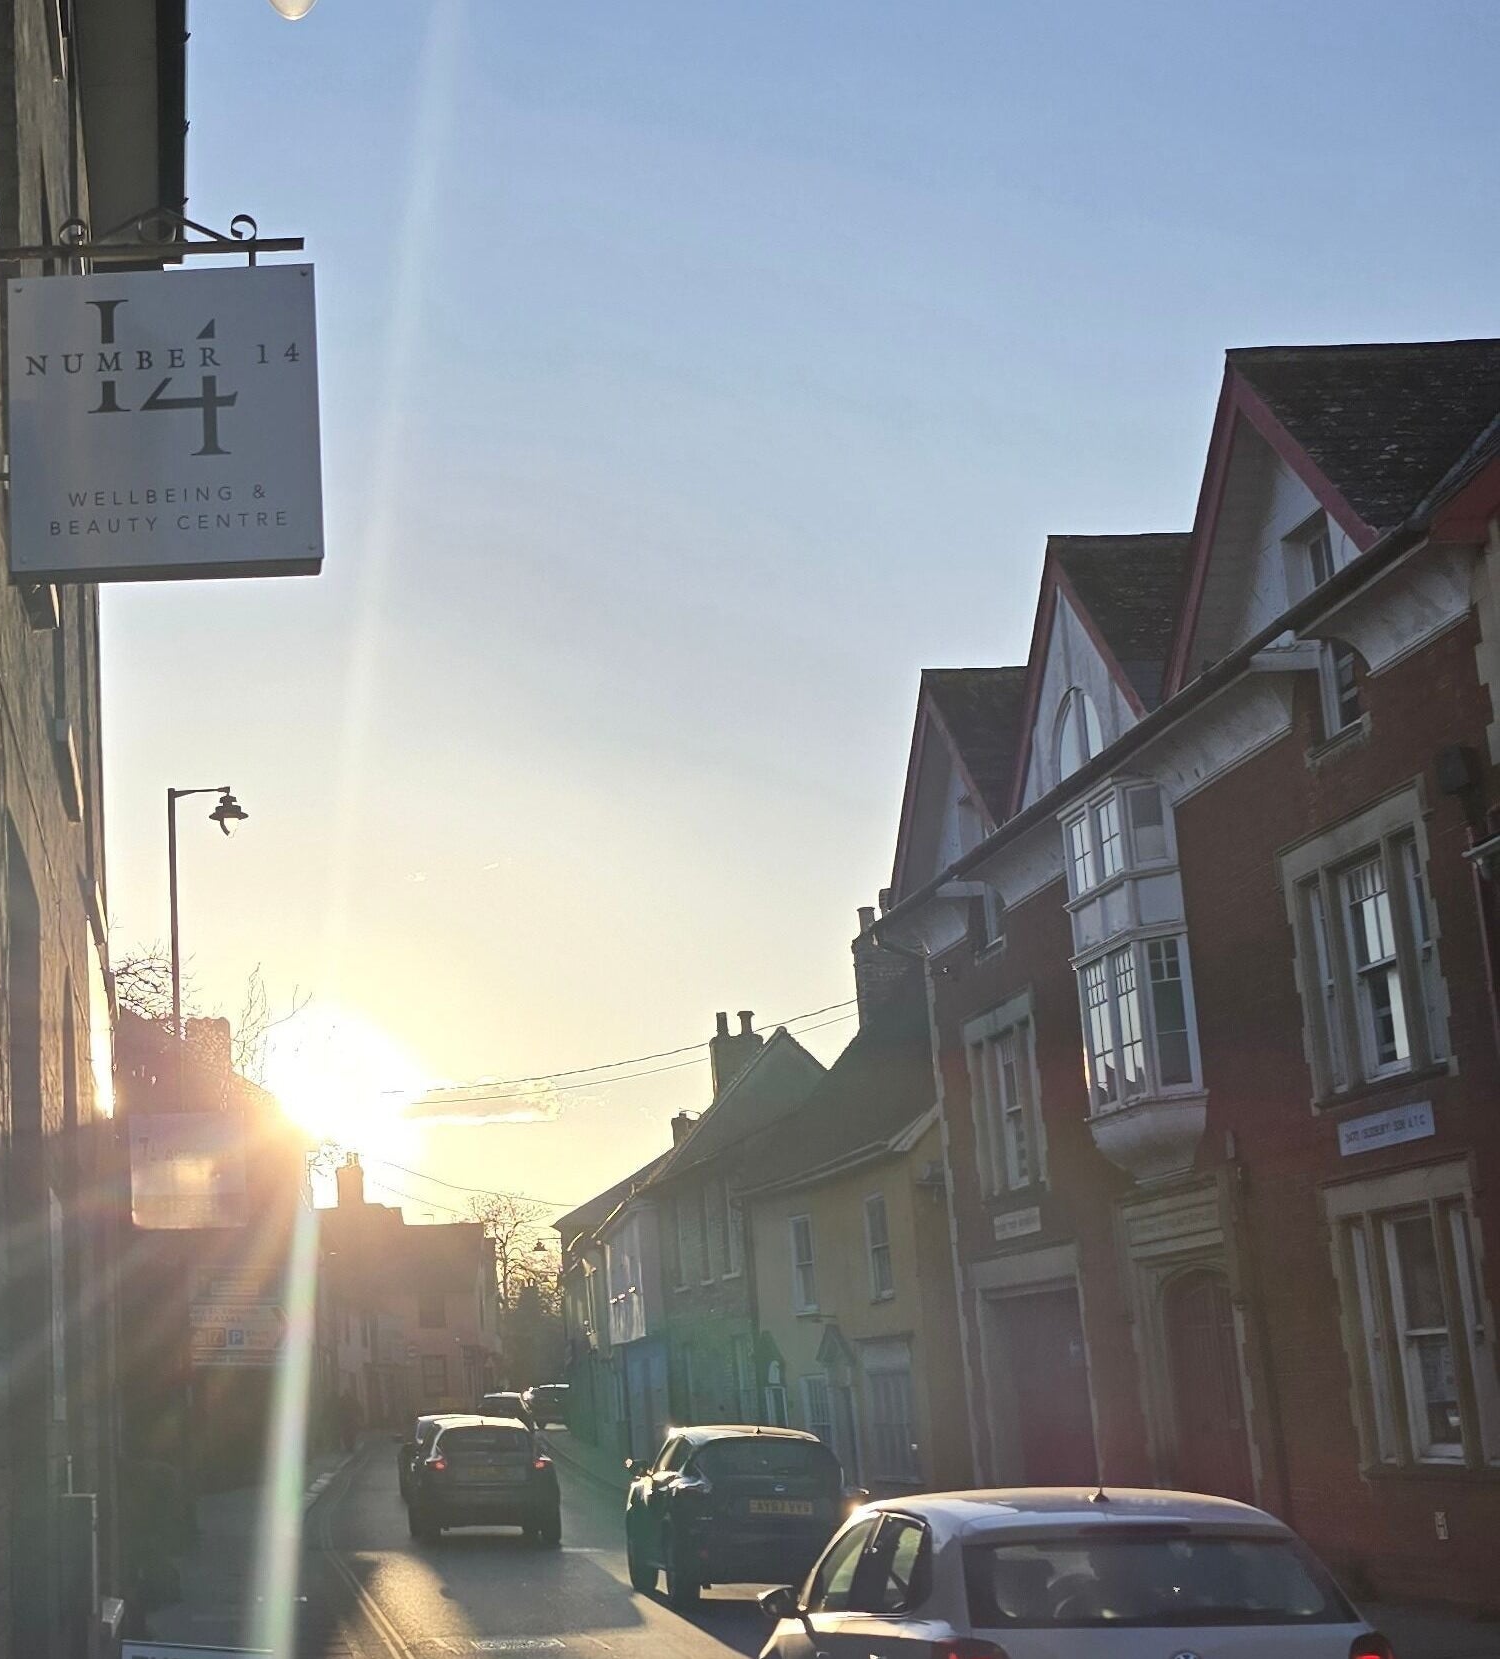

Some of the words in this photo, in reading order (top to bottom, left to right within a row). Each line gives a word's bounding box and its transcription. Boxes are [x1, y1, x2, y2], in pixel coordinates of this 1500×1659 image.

[26, 347, 220, 376] NUMBER
[257, 343, 300, 364] 14
[68, 486, 232, 507] WELLBEING
[253, 485, 266, 499] &
[50, 516, 157, 536] BEAUTY
[177, 511, 287, 531] CENTRE
